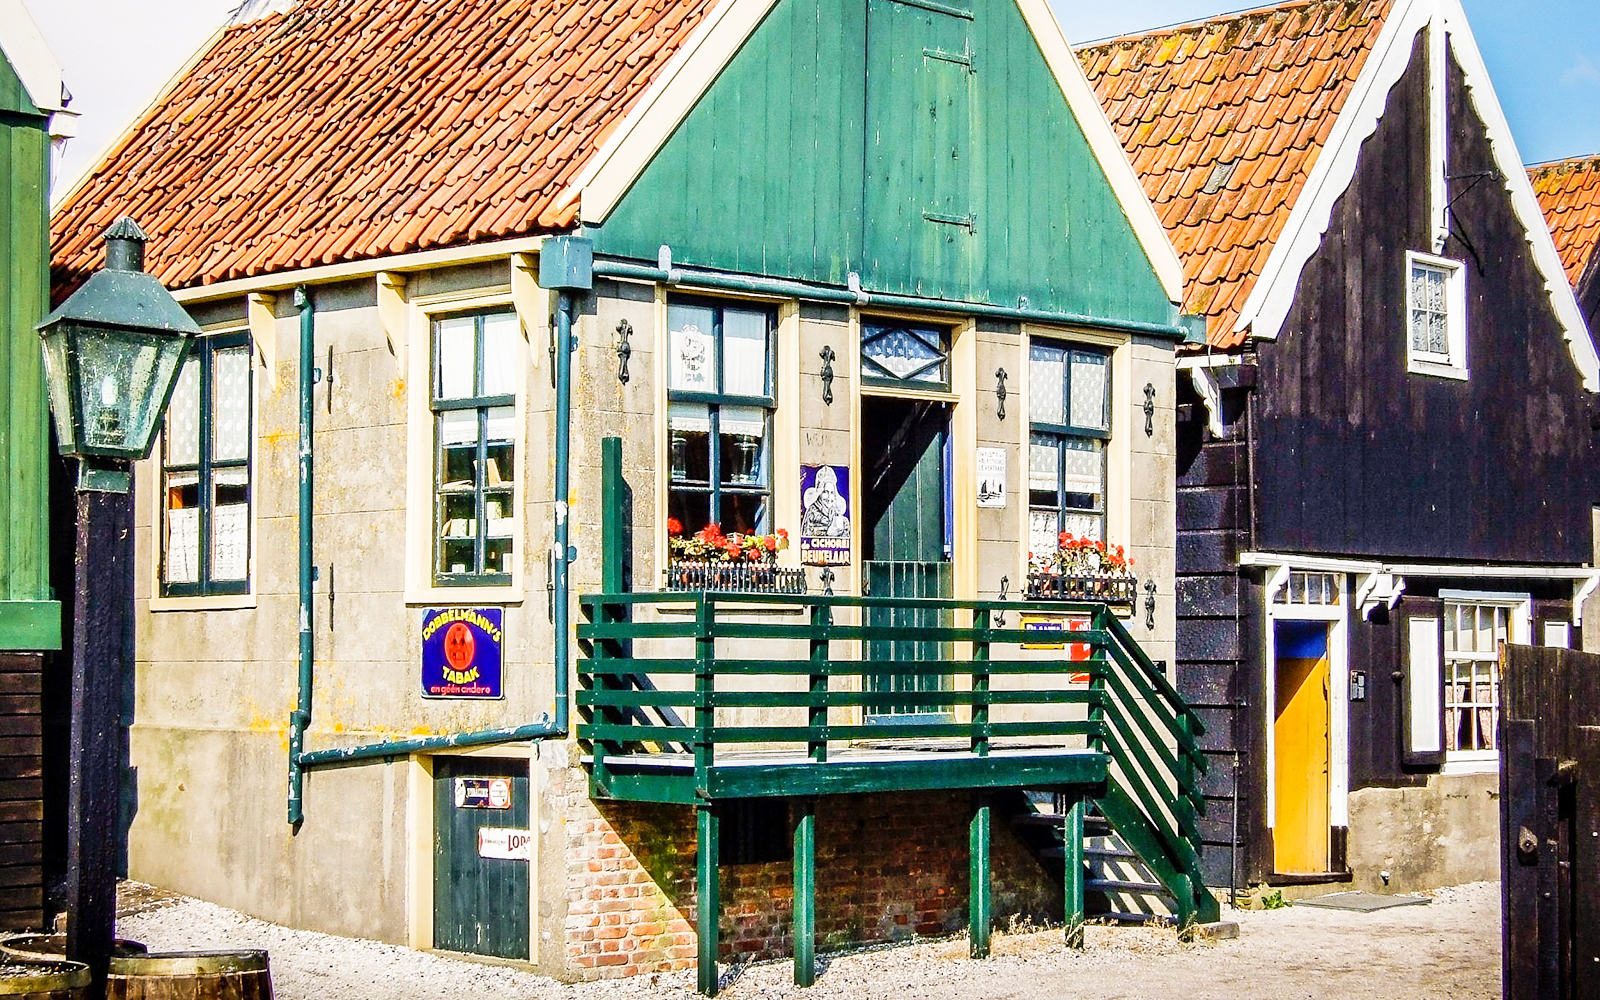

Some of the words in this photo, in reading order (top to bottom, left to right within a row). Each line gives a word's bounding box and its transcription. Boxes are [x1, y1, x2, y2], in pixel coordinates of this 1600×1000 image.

[801, 549, 850, 563] BEUKELAAR
[422, 608, 502, 642] DOBBELMANN'S
[442, 665, 479, 684] TABAK
[430, 685, 440, 693] en
[460, 682, 491, 694] andere
